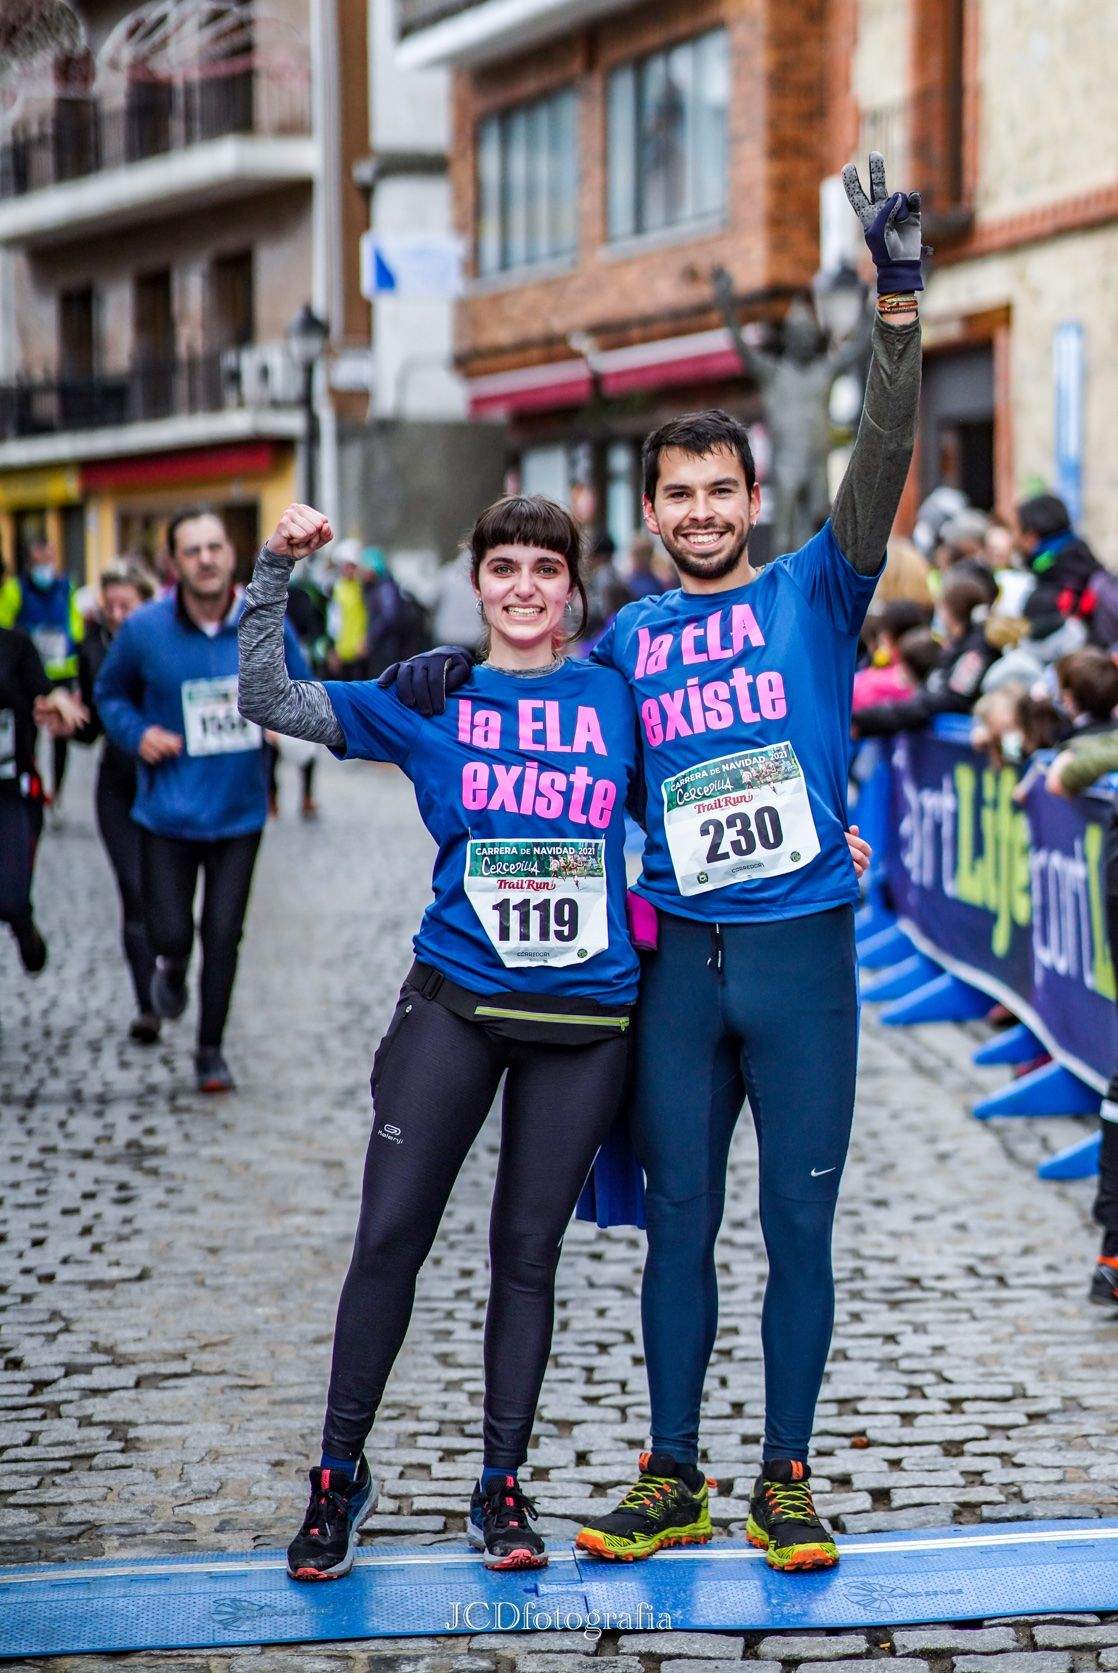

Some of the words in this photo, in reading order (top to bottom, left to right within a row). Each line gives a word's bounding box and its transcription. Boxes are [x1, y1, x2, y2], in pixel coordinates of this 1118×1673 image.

[633, 627, 673, 680] la
[680, 603, 766, 666] ELA
[457, 699, 502, 751] la
[518, 699, 608, 756] ELA
[641, 666, 788, 749] existe
[462, 760, 618, 829] existe
[671, 770, 709, 791] CARRERA
[722, 755, 766, 772] NAVIDAD
[770, 750, 788, 761] 2021
[475, 847, 518, 856] CARRERA
[520, 847, 531, 855] DE
[533, 846, 575, 855] NAVIDAD
[578, 847, 596, 855] 2021
[699, 806, 784, 864] 230
[491, 897, 579, 942] 1119
